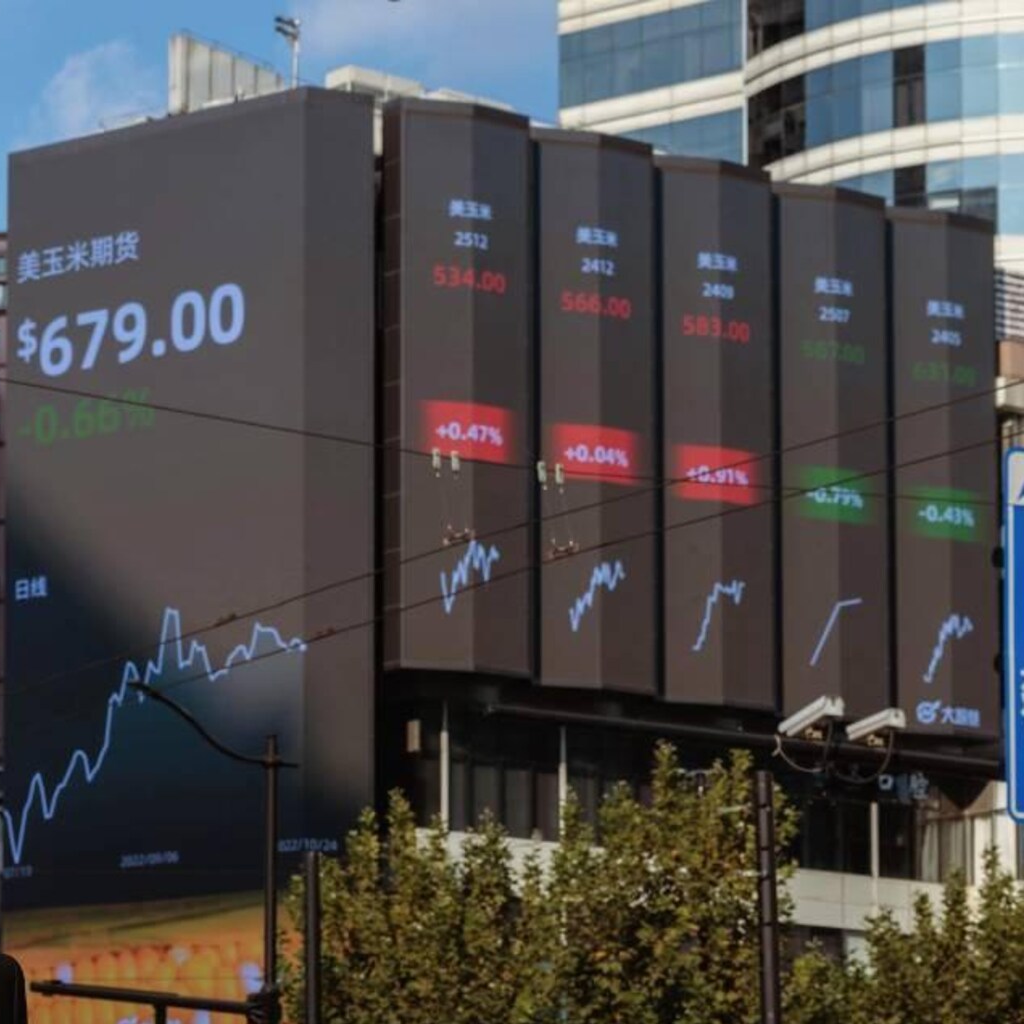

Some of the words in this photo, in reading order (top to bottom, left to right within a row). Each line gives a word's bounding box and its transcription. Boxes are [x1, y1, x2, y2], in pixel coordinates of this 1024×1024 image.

[453, 231, 488, 250] 2512
[16, 230, 140, 284] 美玉米期货
[580, 257, 615, 277] 2412
[432, 263, 507, 295] 534.00
[17, 282, 246, 378] $679.00
[436, 421, 503, 446] +0.47%
[564, 443, 629, 468] +0.04%
[15, 576, 48, 601] 日线
